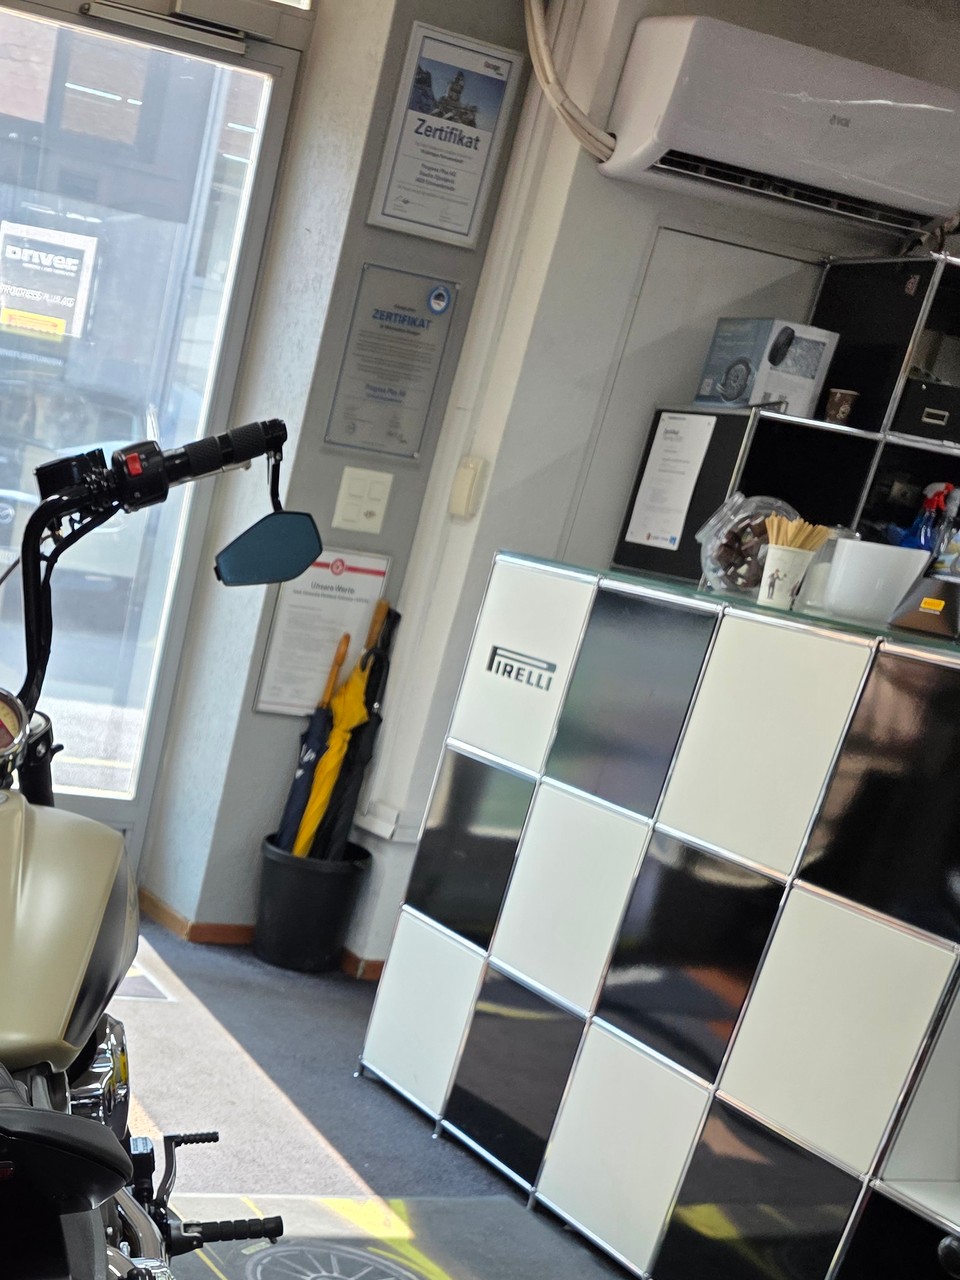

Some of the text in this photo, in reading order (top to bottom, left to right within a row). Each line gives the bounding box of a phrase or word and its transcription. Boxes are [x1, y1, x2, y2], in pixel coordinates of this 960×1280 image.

[414, 117, 481, 151] Zertifikat
[372, 308, 432, 330] ZERTIFIKAT
[486, 645, 557, 692] PIRELLI
